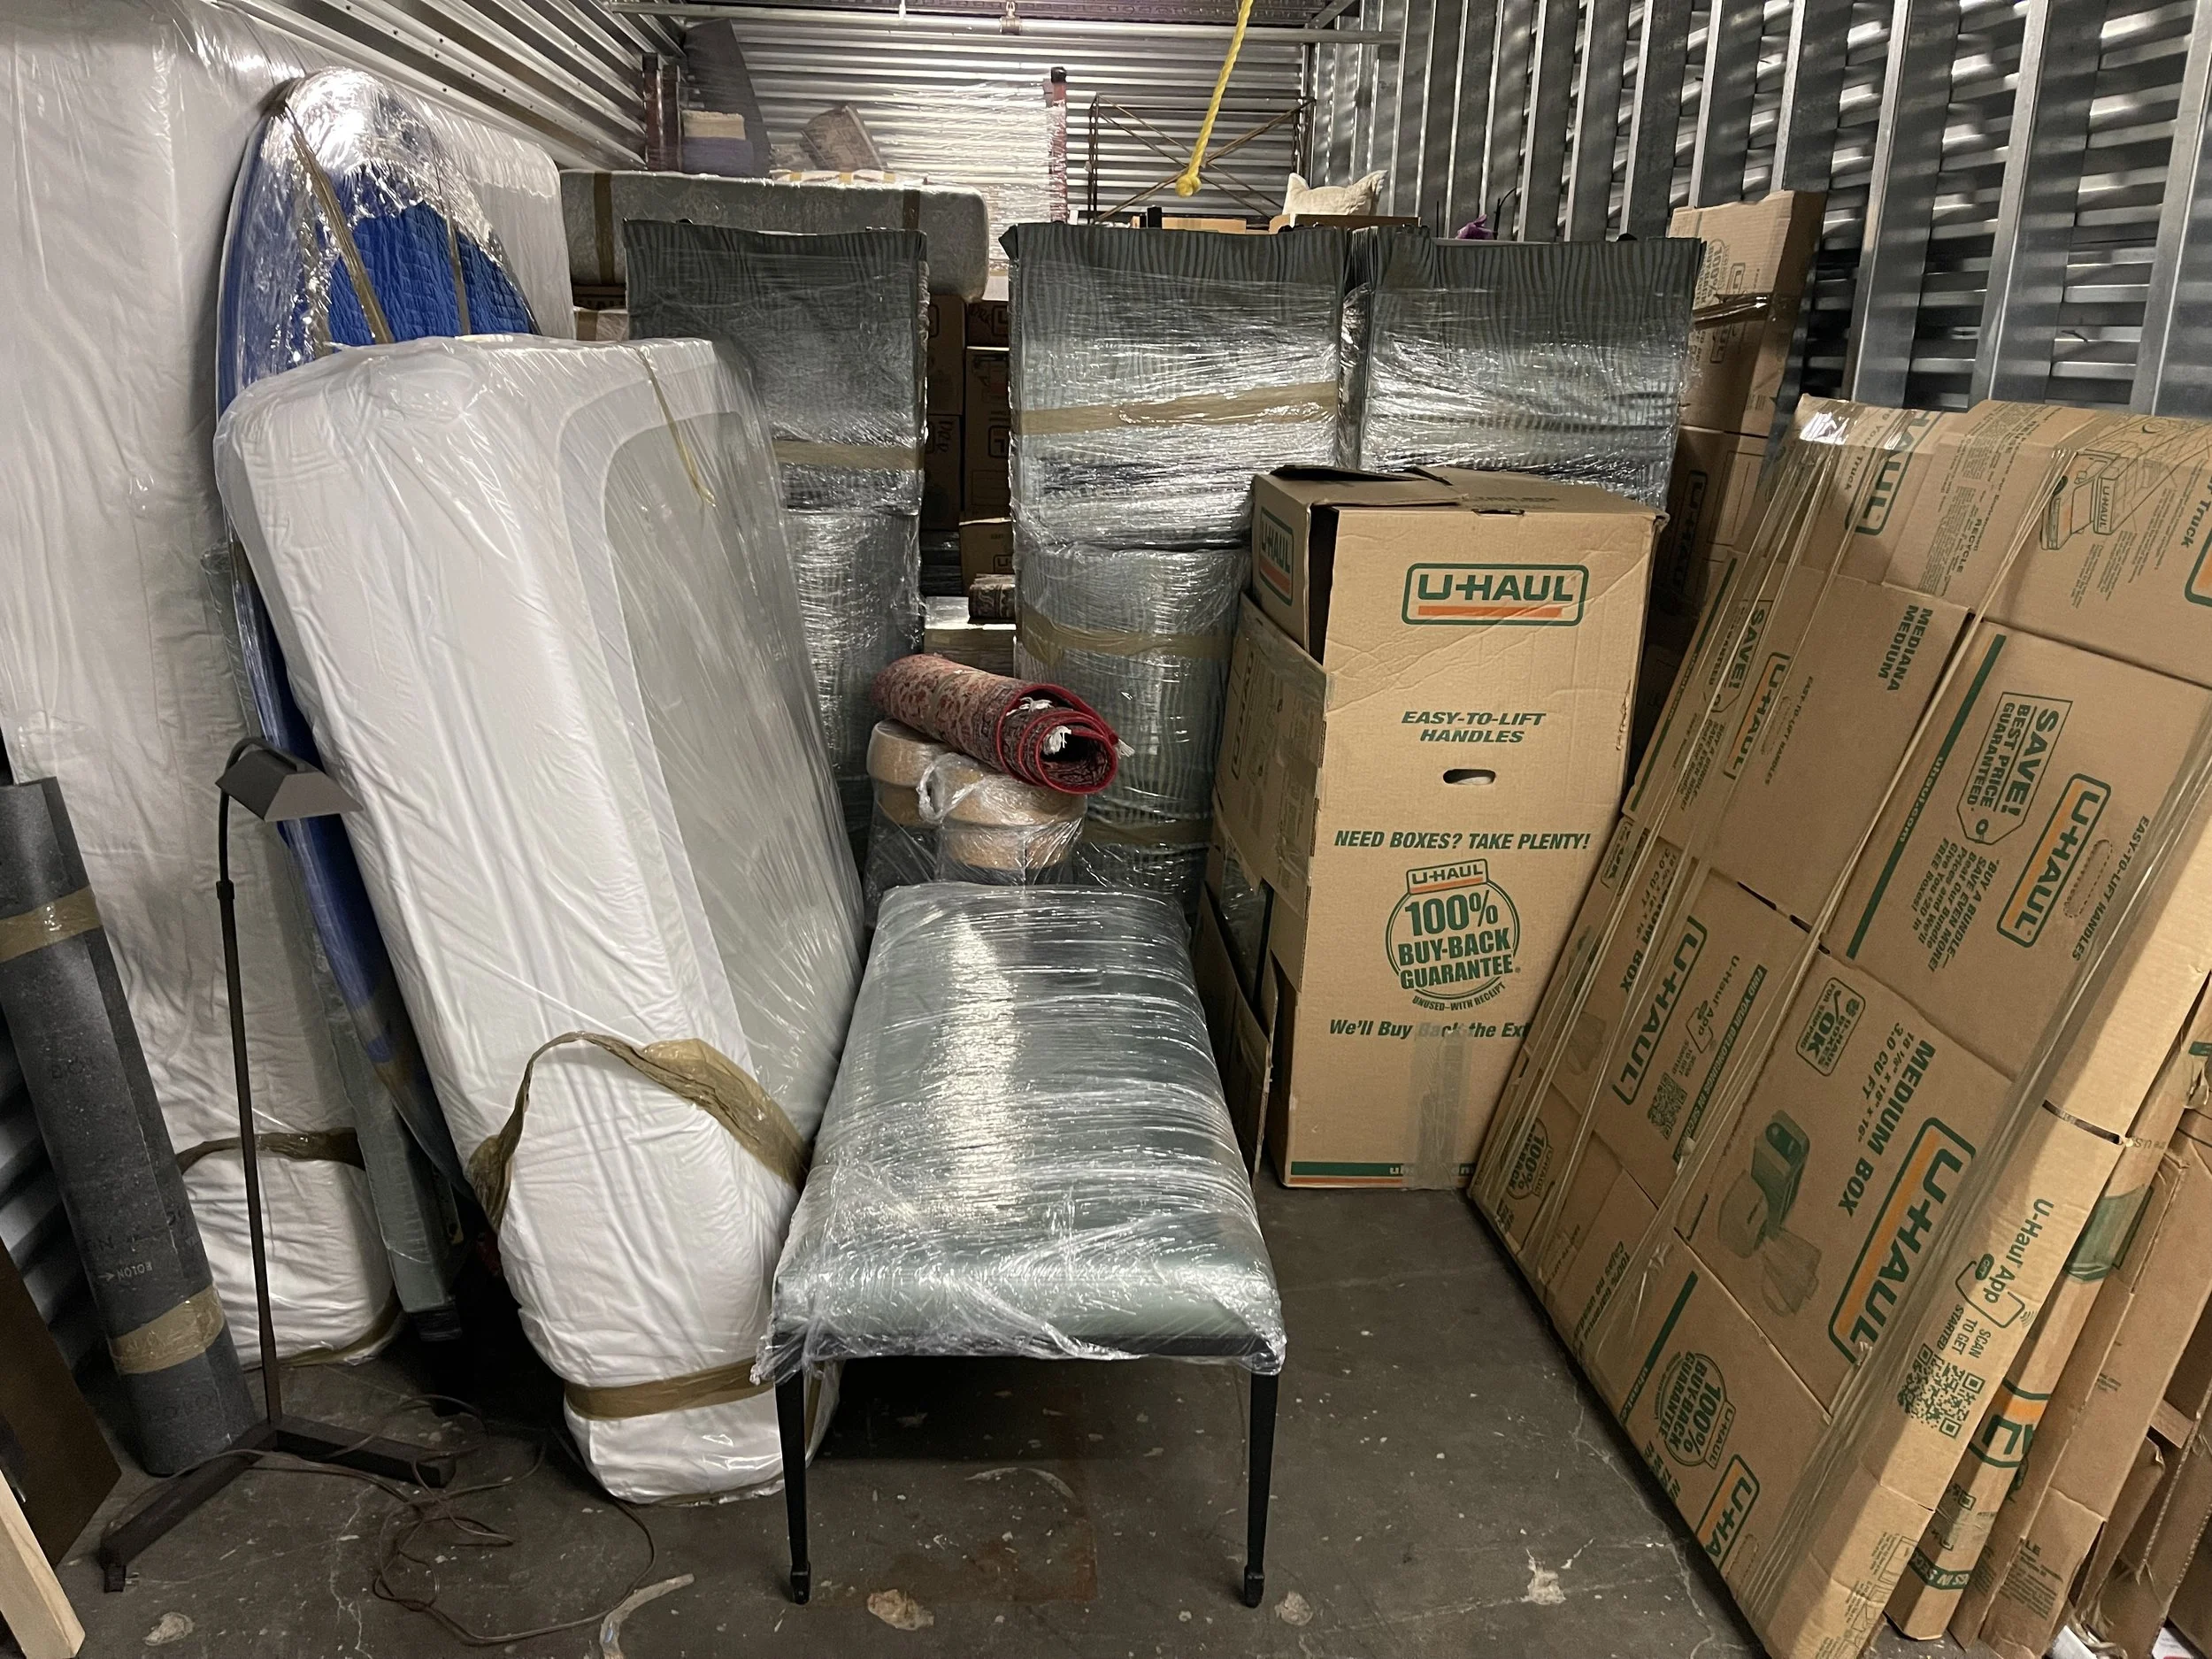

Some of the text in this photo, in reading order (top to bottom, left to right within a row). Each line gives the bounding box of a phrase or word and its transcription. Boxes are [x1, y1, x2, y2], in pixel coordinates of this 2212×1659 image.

[1844, 457, 1863, 489] Truck
[2096, 487, 2110, 529] U-HAUL
[2180, 500, 2212, 545] Truck
[1260, 517, 1292, 572] U-HAUL
[1955, 518, 1982, 573] RECYCLE
[1417, 574, 1573, 602] U-HAUL
[1727, 606, 1766, 689] SAVE!
[1878, 603, 1919, 680] MEDIUM
[1887, 607, 1933, 693] MEDIANA
[1401, 711, 1547, 726] EASY-TO-LIFT
[1420, 729, 1525, 743] HANDLES
[1732, 663, 1786, 769] U-HAUL
[1978, 703, 2032, 809] BEST PRICE
[1999, 707, 2062, 818] SAVE!
[1898, 756, 1946, 842] uhaul.com
[1334, 830, 1591, 849] NEED BOXES? TAKE PLENTY!
[1940, 841, 1959, 870] Give
[2013, 789, 2101, 932] U-HAUL
[1411, 863, 1484, 886] U-HAUL
[1640, 848, 1671, 908] 3.0 CU FT
[1909, 837, 1949, 912] FREE Boxes!
[1916, 846, 1968, 945] Prices and We'll
[1924, 850, 1978, 949] Beat Our Bundle
[1928, 872, 1945, 894] You
[1971, 889, 1983, 902] A
[2070, 814, 2150, 962] EASY-TO-LIFT HANDLES
[1405, 890, 1499, 937] 100%
[1918, 895, 1933, 917] $20
[1926, 855, 1988, 973] SAVE EVEN MORE!
[1398, 928, 1511, 965] BUY-BACK
[1401, 956, 1513, 989] GUARANTEE
[1618, 949, 1645, 995] BOX
[1474, 981, 1506, 1005] RECEIPT
[1617, 933, 1698, 1085] U-HAUL
[1695, 956, 1740, 1036] U-Haul App
[1747, 968, 1763, 996] FIND
[1330, 1019, 1373, 1035] We'll
[1378, 1020, 1413, 1040] Buy
[1469, 1022, 1496, 1037] the
[1732, 995, 1749, 1027] YOUR
[1800, 982, 1835, 1051] FOR SHIPPING
[1806, 1010, 1836, 1059] OK
[1703, 1025, 1735, 1093] BELONGINGS
[1816, 1015, 1846, 1066] BOXES
[1824, 1018, 1851, 1067] U-HAUL
[1860, 1020, 1904, 1100] 3.0 CU FT
[1900, 1029, 1914, 1050] 18
[1836, 1038, 1937, 1218] MEDIUM BOX
[1516, 1136, 1546, 1190] 100%
[1850, 1148, 1963, 1348] U-HAUL
[1979, 1196, 2055, 1304] U-Haul App
[1935, 1303, 1963, 1351] STARTED
[1950, 1317, 1978, 1355] TO GET
[1967, 1327, 1992, 1359] SCAN
[1655, 1350, 1696, 1440] GUARANTEE
[1668, 1359, 1708, 1450] BUY-BACK
[1681, 1382, 1722, 1455] 100%
[1709, 1408, 1733, 1463] U-HAUL
